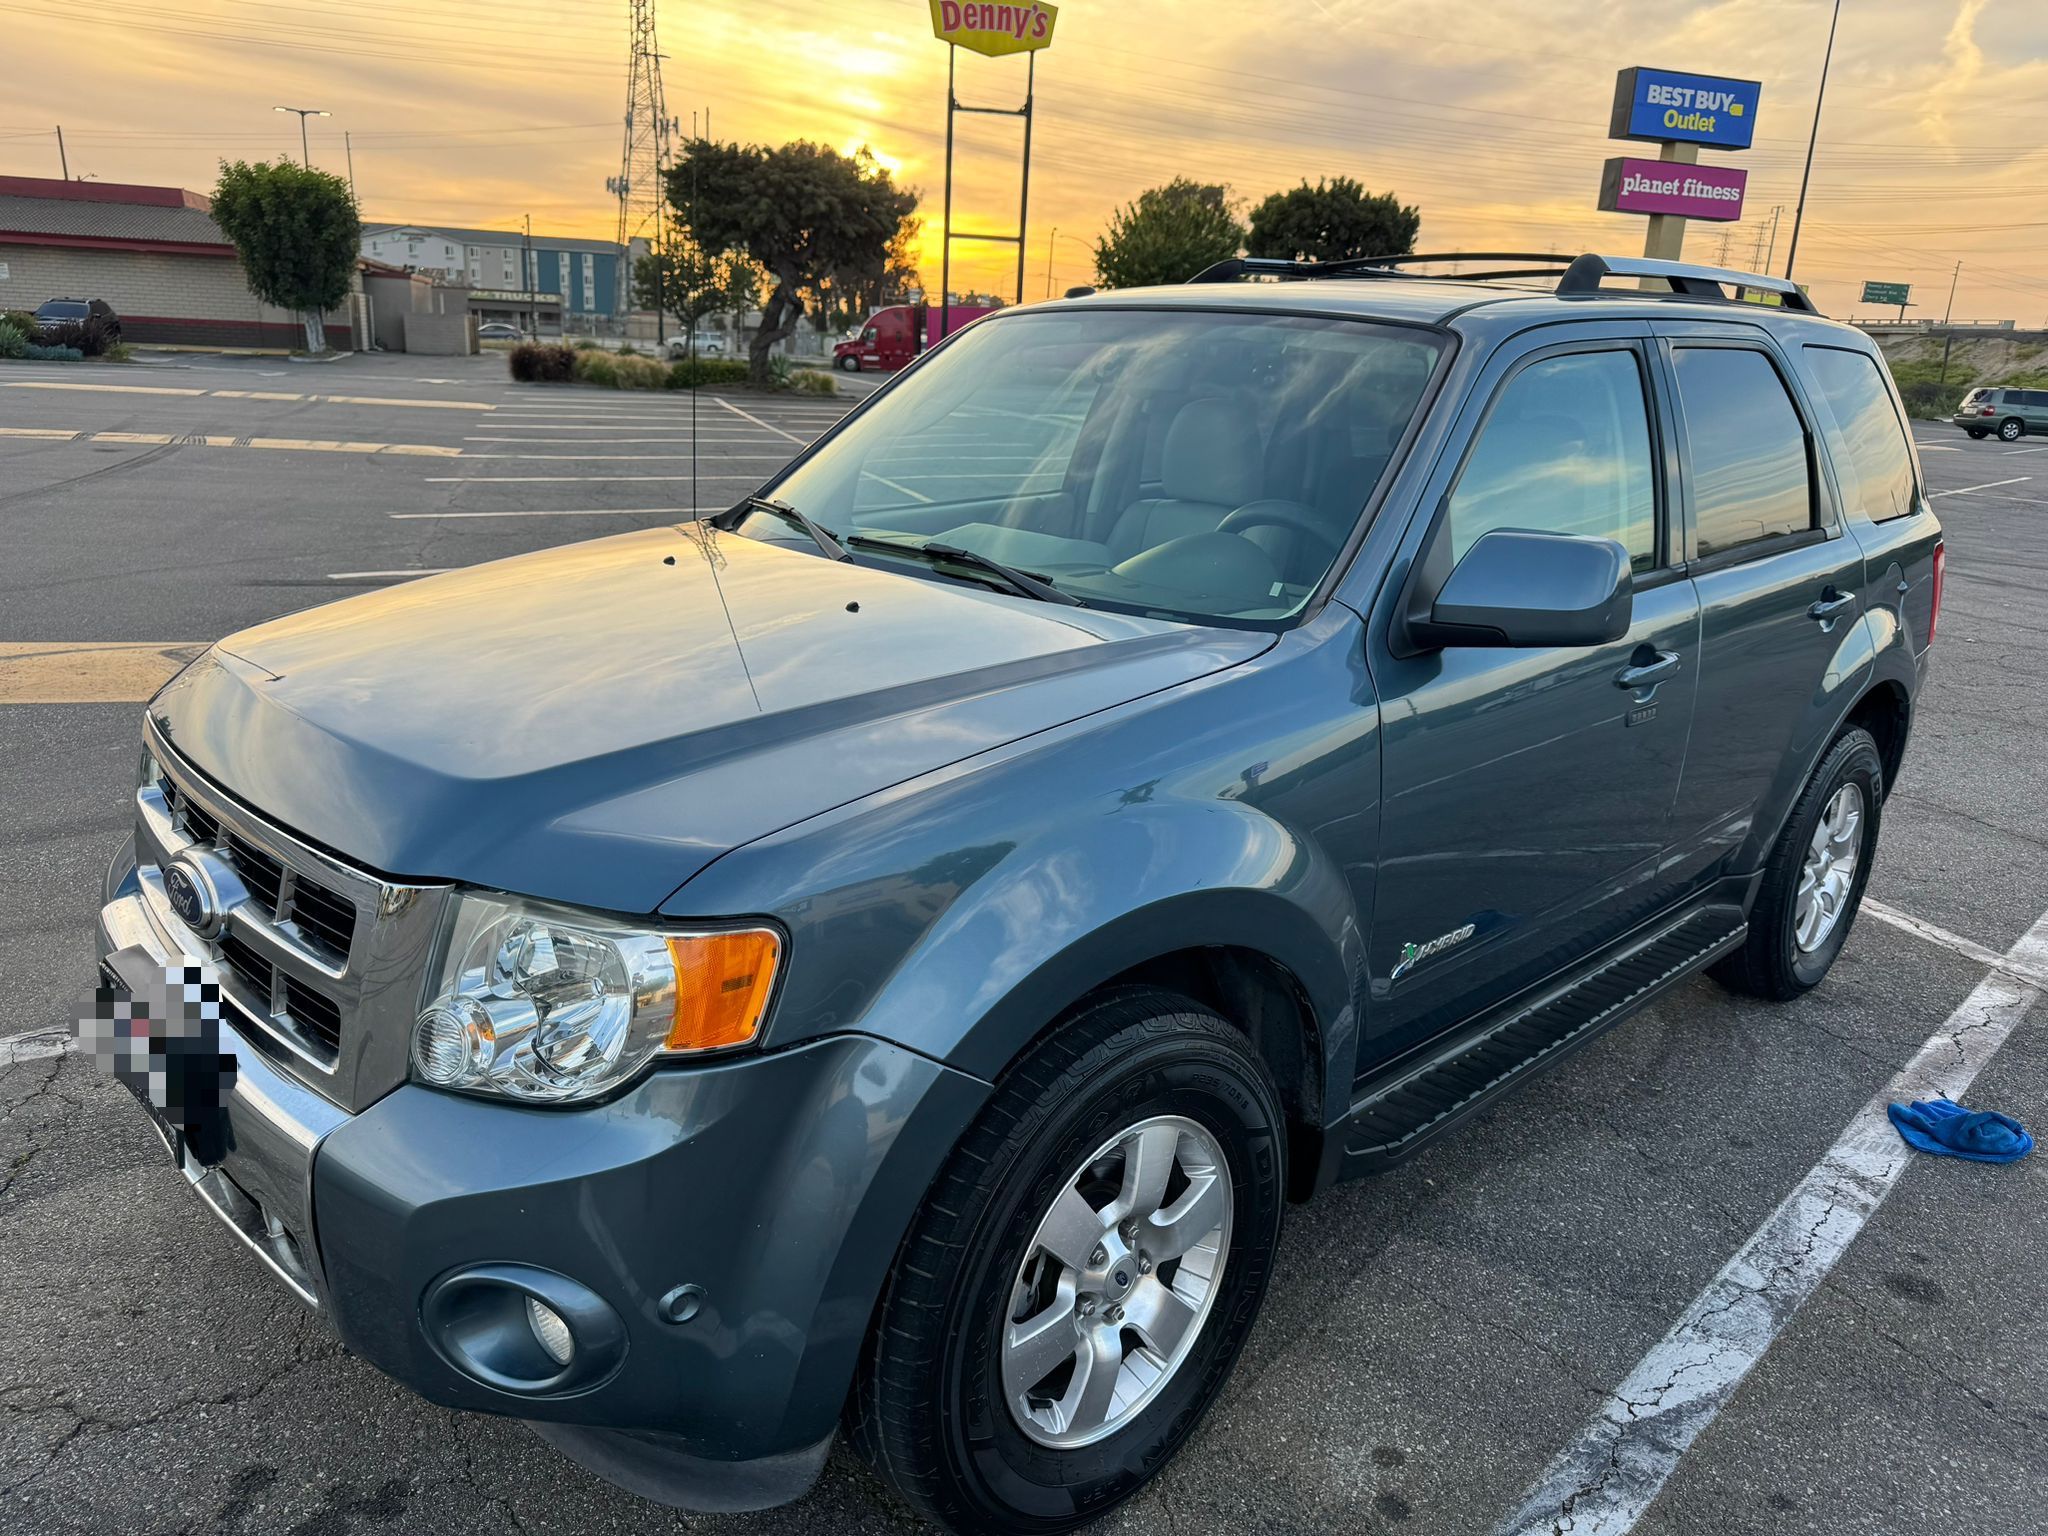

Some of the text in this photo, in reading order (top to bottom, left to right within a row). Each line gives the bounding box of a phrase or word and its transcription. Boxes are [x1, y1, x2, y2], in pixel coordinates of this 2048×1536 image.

[940, 1, 1048, 39] Denny's
[1647, 84, 1735, 112] BEST BUY
[1664, 109, 1715, 132] Outlet
[1621, 173, 1740, 201] planet fitness
[168, 871, 193, 916] Ford
[1415, 923, 1475, 962] HYBRID
